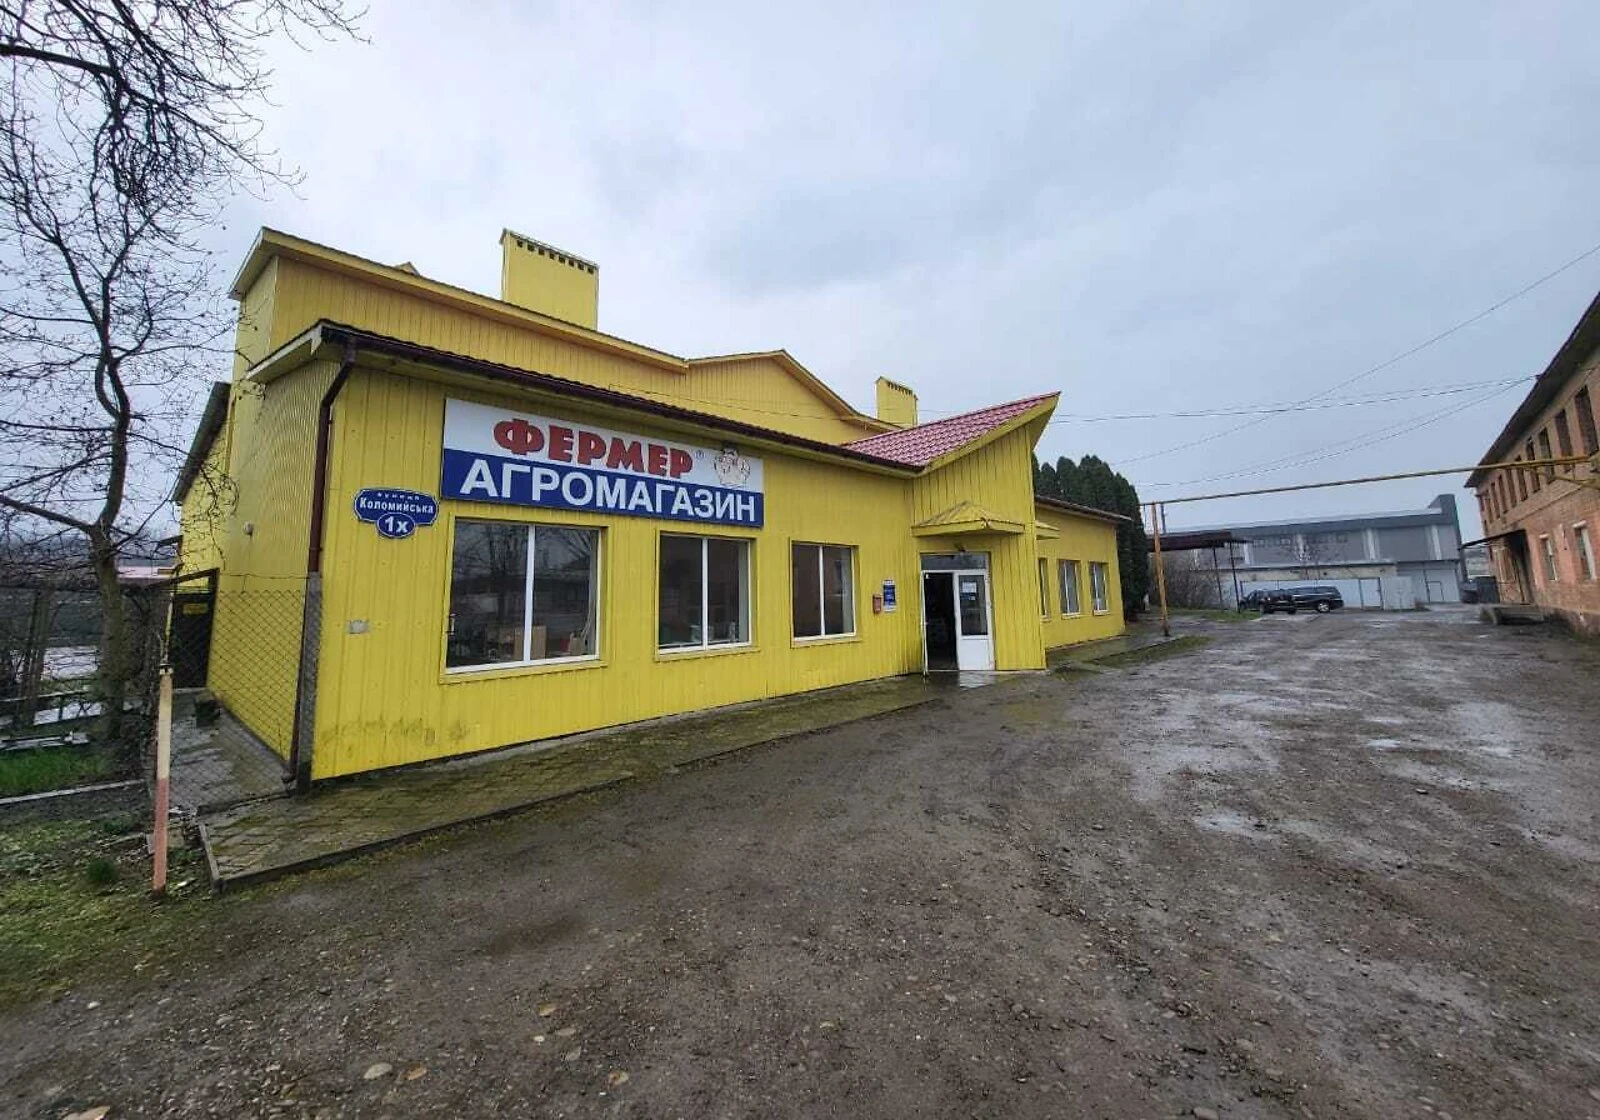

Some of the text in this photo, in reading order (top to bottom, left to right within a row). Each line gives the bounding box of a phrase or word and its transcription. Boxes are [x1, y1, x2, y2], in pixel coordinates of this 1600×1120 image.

[493, 418, 694, 479] ФЕРМЕР
[359, 497, 434, 514] Коломийська
[459, 458, 755, 522] АГРОМАГАЗИН
